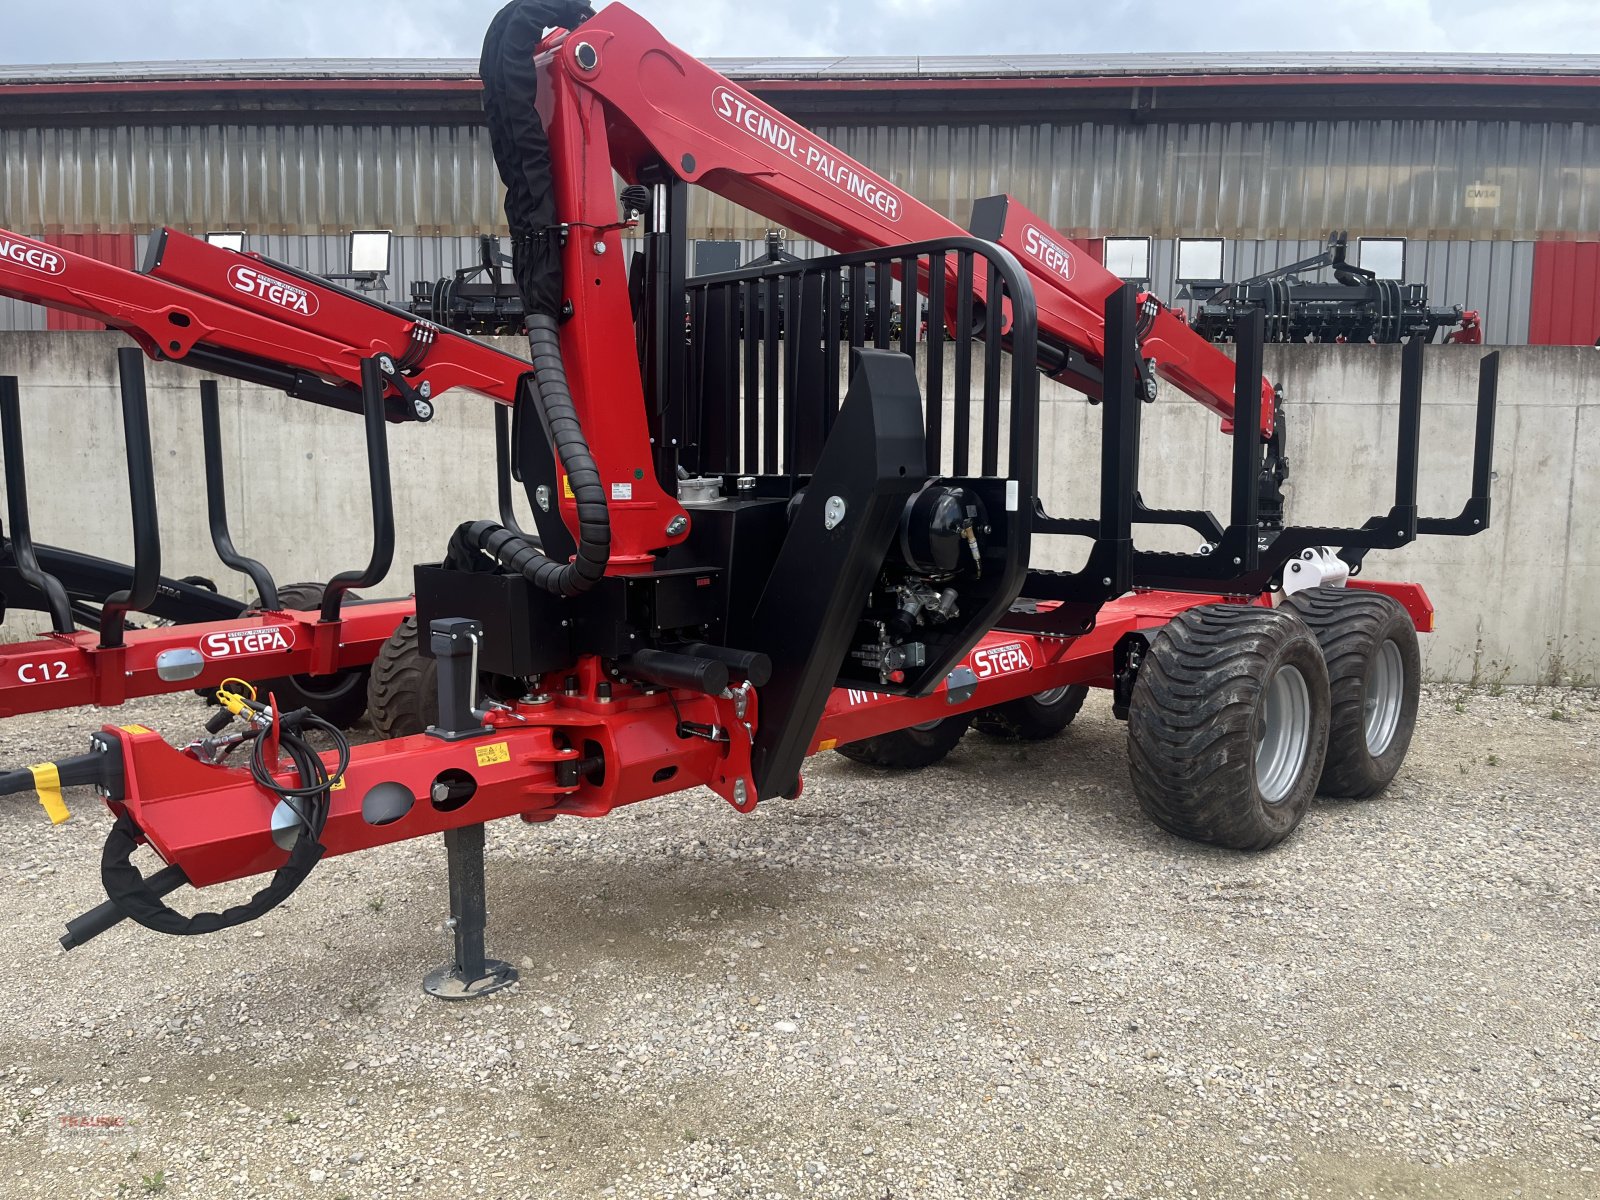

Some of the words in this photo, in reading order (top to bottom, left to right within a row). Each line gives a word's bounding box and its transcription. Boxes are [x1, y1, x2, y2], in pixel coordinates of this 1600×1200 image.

[718, 92, 898, 218] STEINDL-PALFINGER
[1025, 227, 1069, 279] STEPA
[234, 267, 309, 314] STEPA
[207, 632, 289, 657] STEPA
[974, 648, 1030, 678] STEPA
